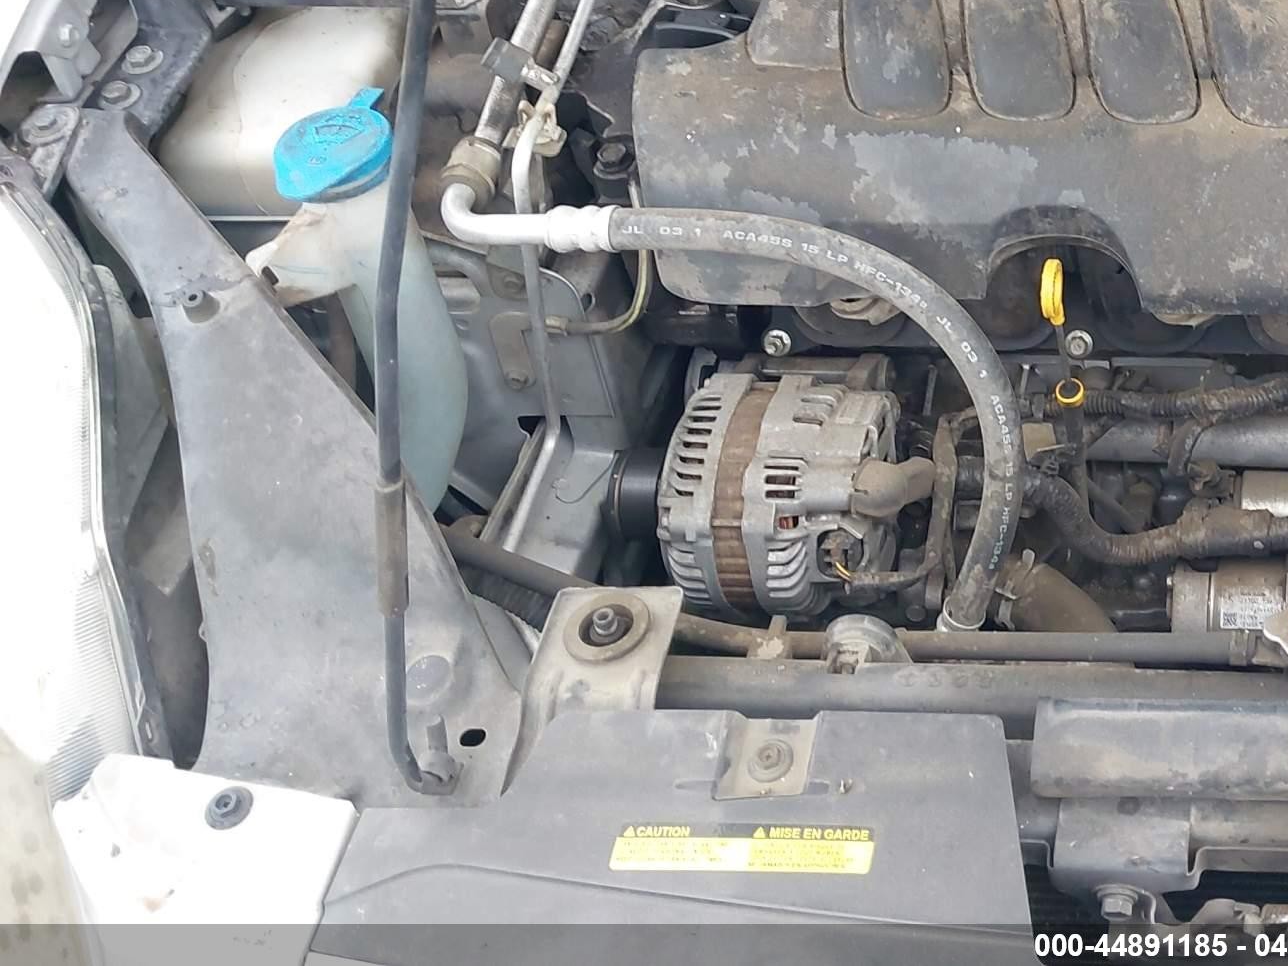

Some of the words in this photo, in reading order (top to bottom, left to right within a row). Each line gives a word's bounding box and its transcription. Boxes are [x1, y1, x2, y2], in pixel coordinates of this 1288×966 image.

[723, 230, 793, 249] ACA45S
[800, 243, 820, 256] 15
[826, 250, 849, 263] LP
[636, 826, 691, 838] CAUTION
[769, 827, 801, 839] MISE
[803, 828, 822, 839] EN
[824, 829, 869, 841] GARDE
